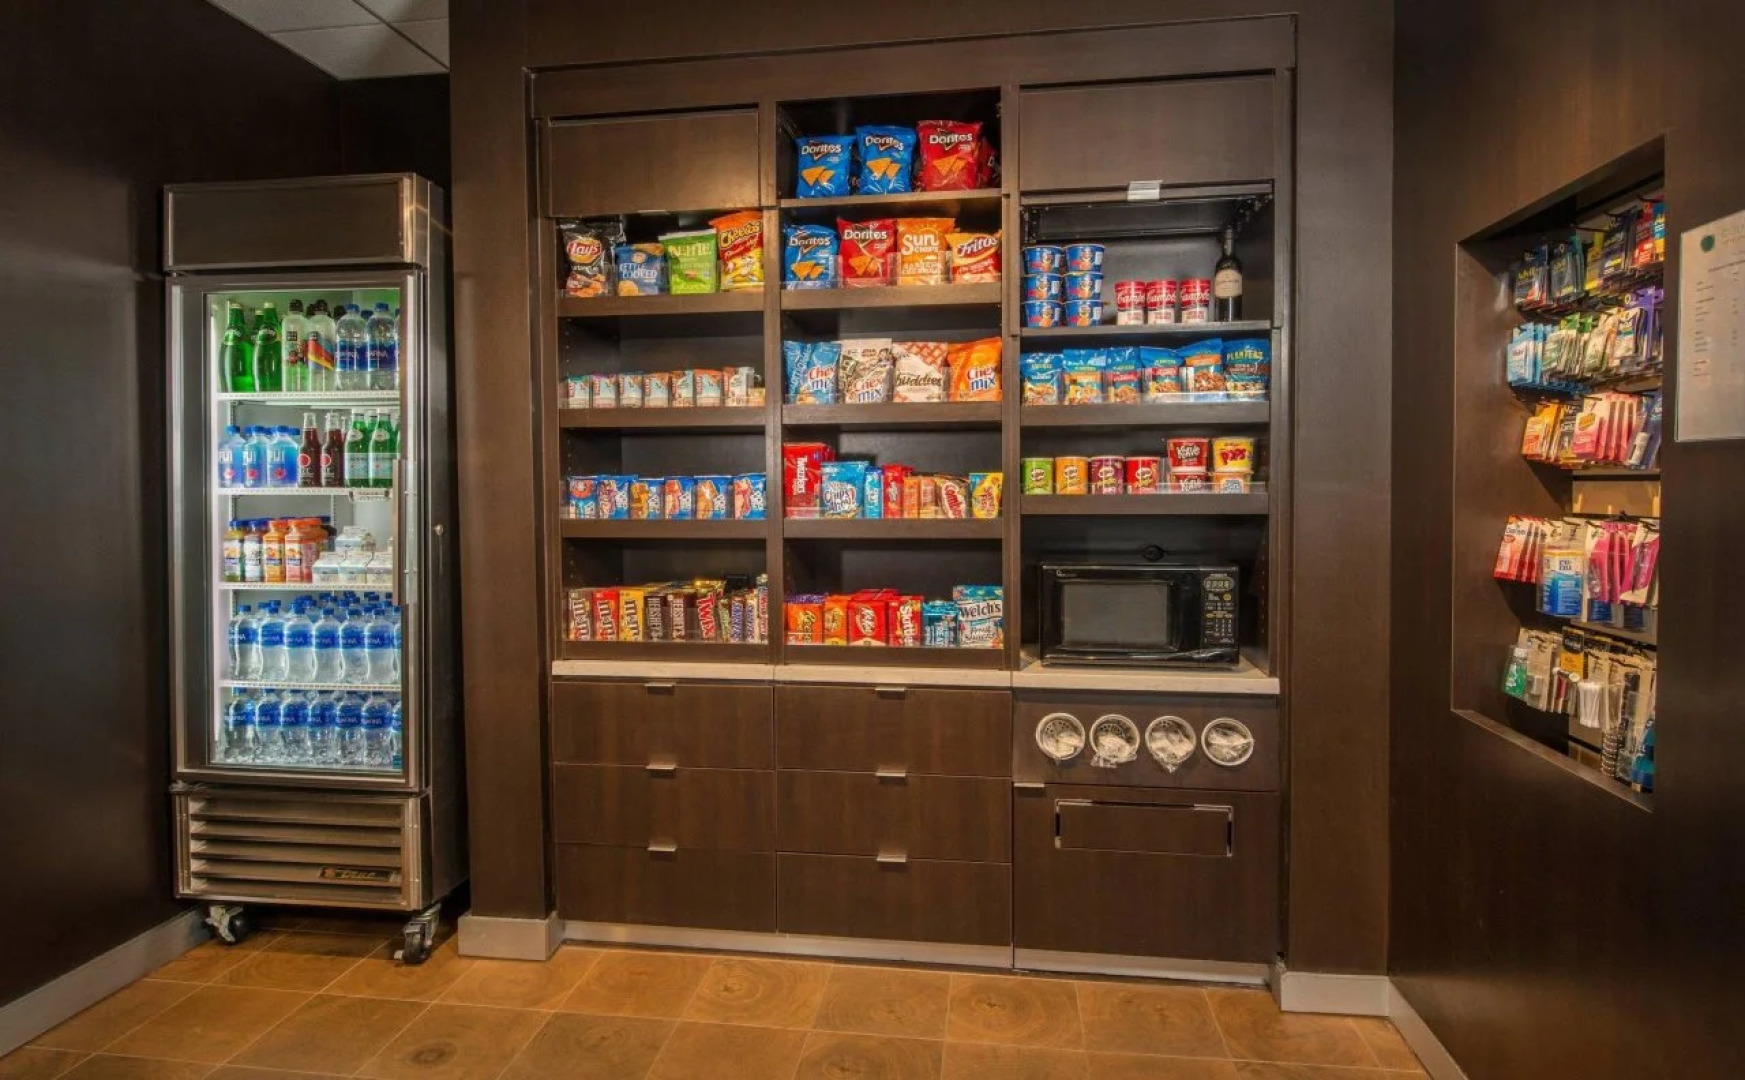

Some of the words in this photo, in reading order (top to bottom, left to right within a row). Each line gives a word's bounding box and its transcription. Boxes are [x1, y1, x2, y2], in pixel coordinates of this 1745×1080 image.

[865, 135, 904, 151] Doritos
[929, 133, 973, 146] Doritos
[801, 143, 841, 156] Doritos
[720, 220, 763, 249] Cheetos
[789, 234, 831, 247] Doritos
[843, 228, 888, 241] Doritos
[901, 233, 940, 256] Sun
[959, 236, 997, 257] Fritos
[971, 378, 996, 392] mix
[959, 602, 1001, 619] Welch's
